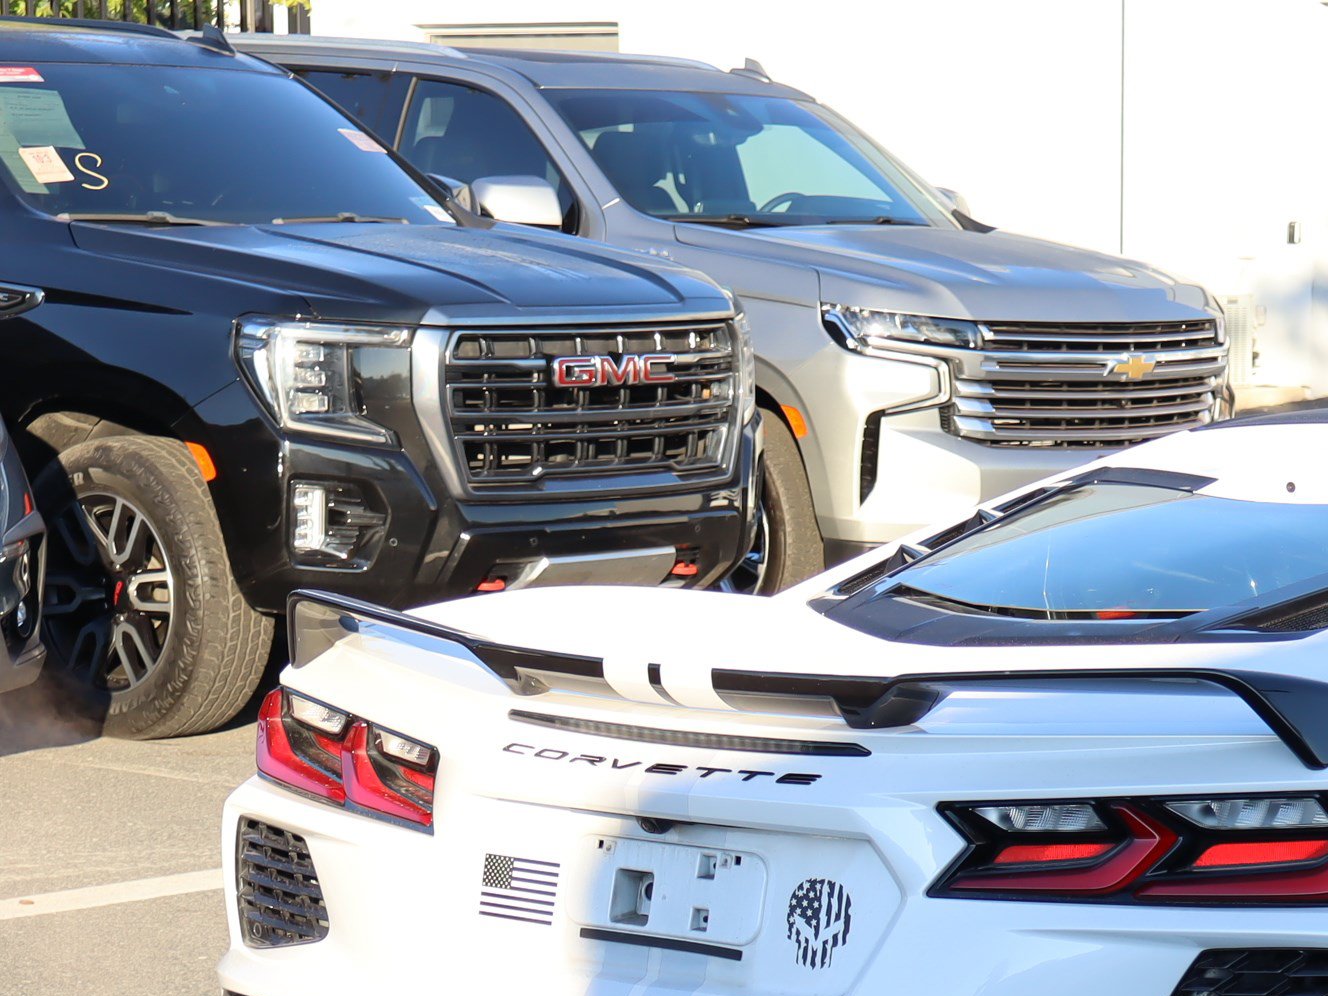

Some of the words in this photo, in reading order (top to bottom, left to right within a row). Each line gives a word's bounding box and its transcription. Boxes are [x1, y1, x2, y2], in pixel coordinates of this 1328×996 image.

[75, 152, 109, 190] S
[553, 353, 676, 388] GMC
[502, 743, 823, 785] CORVETTE
